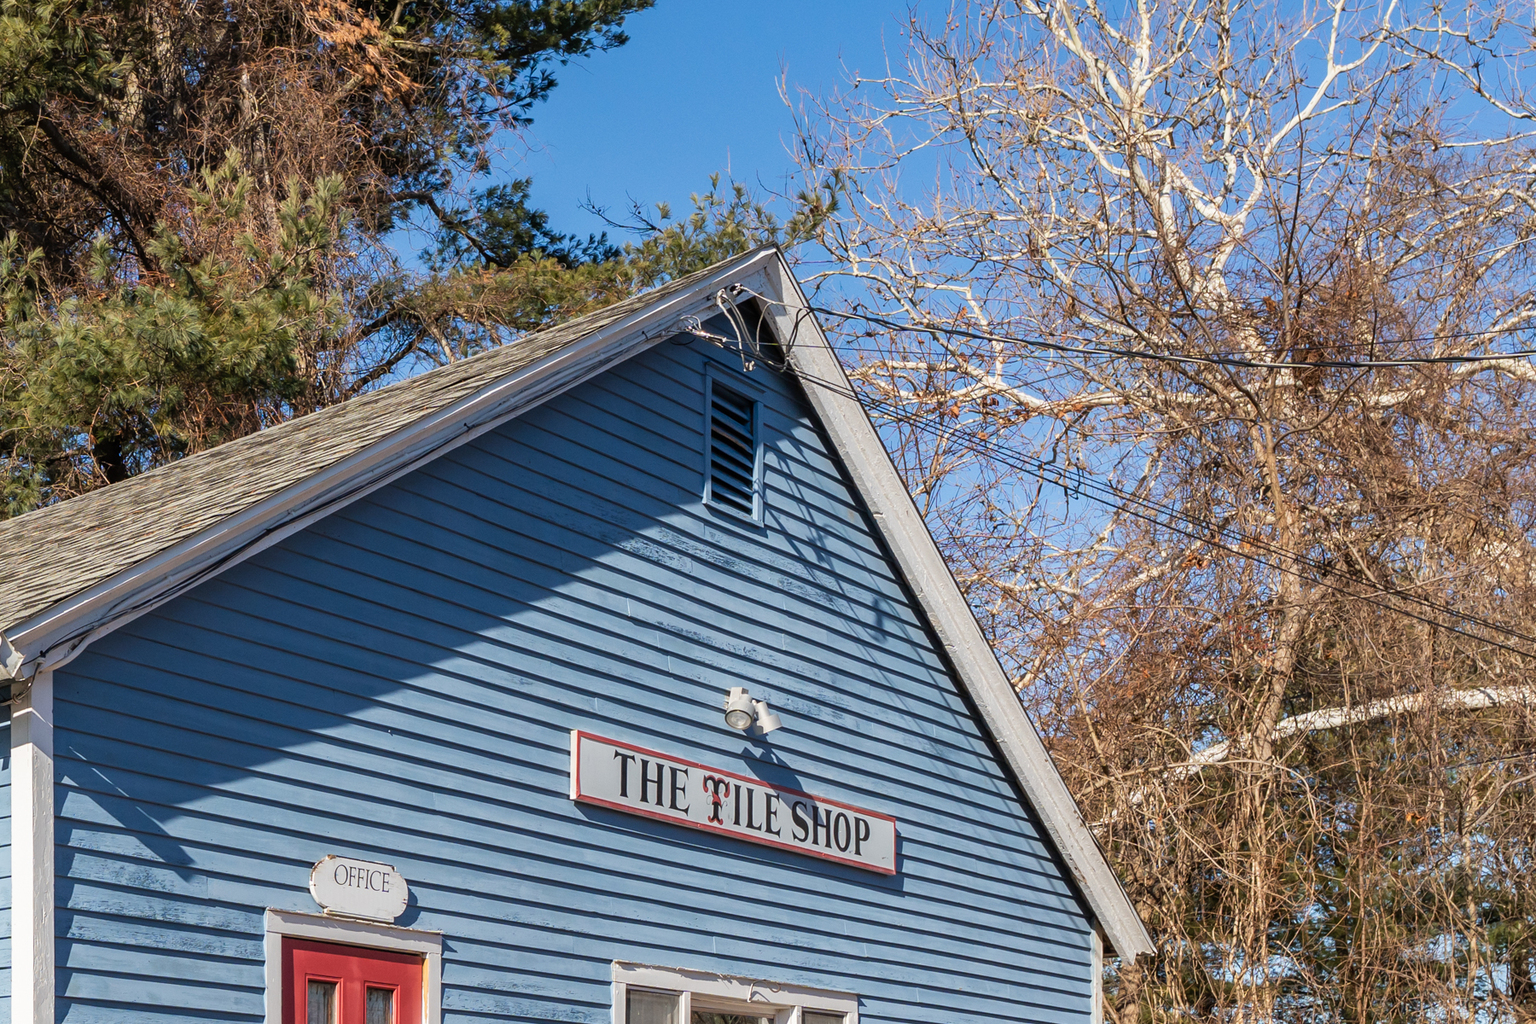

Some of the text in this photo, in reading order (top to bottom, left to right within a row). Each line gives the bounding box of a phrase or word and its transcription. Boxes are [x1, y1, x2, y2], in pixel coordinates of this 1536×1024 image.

[613, 750, 870, 856] THE TILE SHOP
[334, 864, 390, 893] OFFICE
